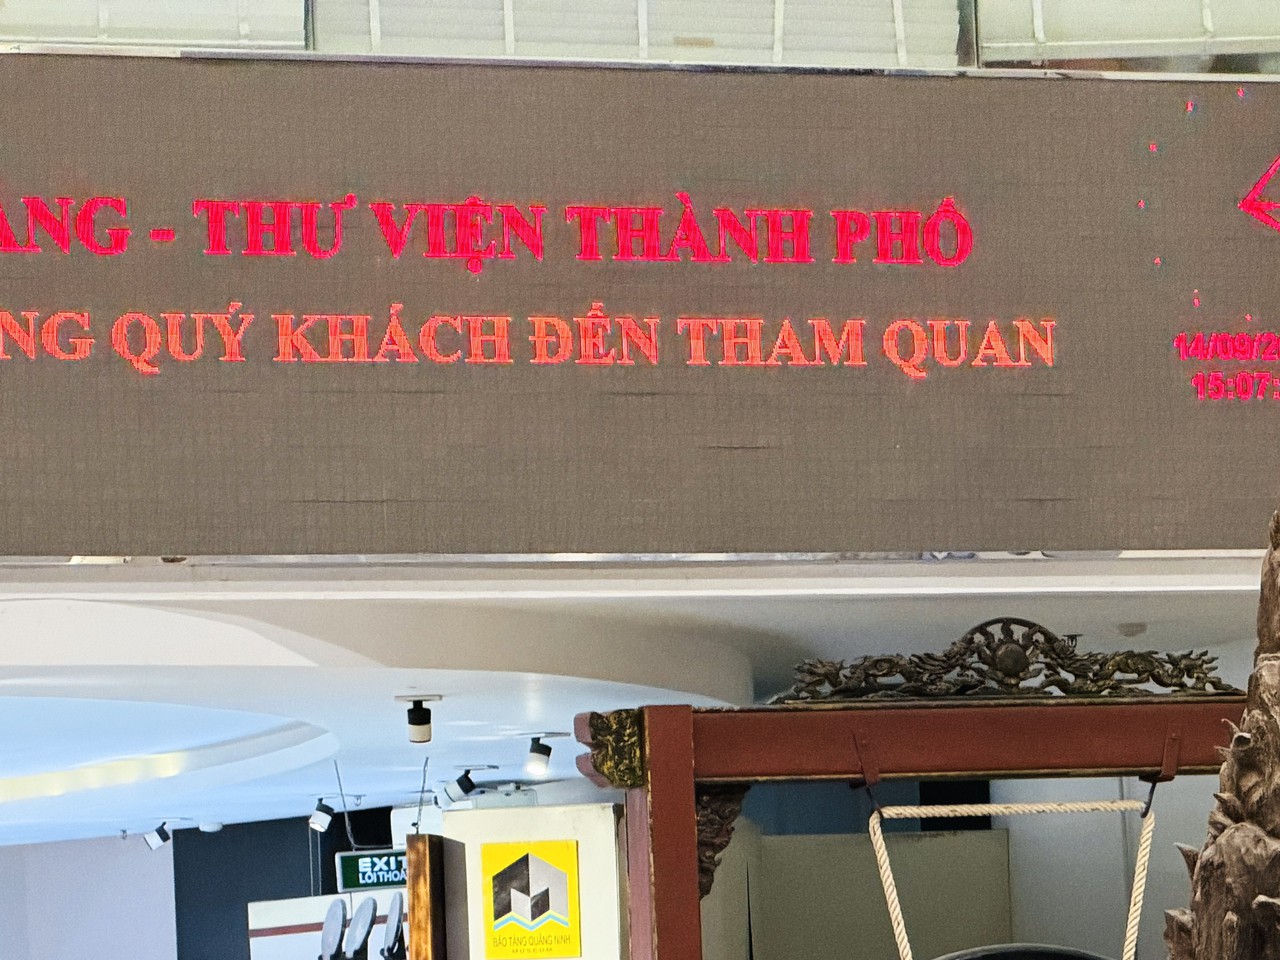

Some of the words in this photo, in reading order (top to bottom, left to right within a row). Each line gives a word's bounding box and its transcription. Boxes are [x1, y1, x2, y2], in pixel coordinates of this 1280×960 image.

[192, 193, 358, 258] THƯ
[369, 195, 548, 275] VIỆN
[564, 191, 814, 264] THÀNH
[829, 196, 974, 267] PHỐ
[111, 302, 254, 375] QUÝ
[273, 302, 512, 363] KHÁCH
[528, 302, 660, 365] ĐẾN
[676, 317, 867, 366] THAM
[882, 318, 1056, 379] QUAN
[359, 856, 407, 872] EXIT
[554, 934, 571, 944] NINH
